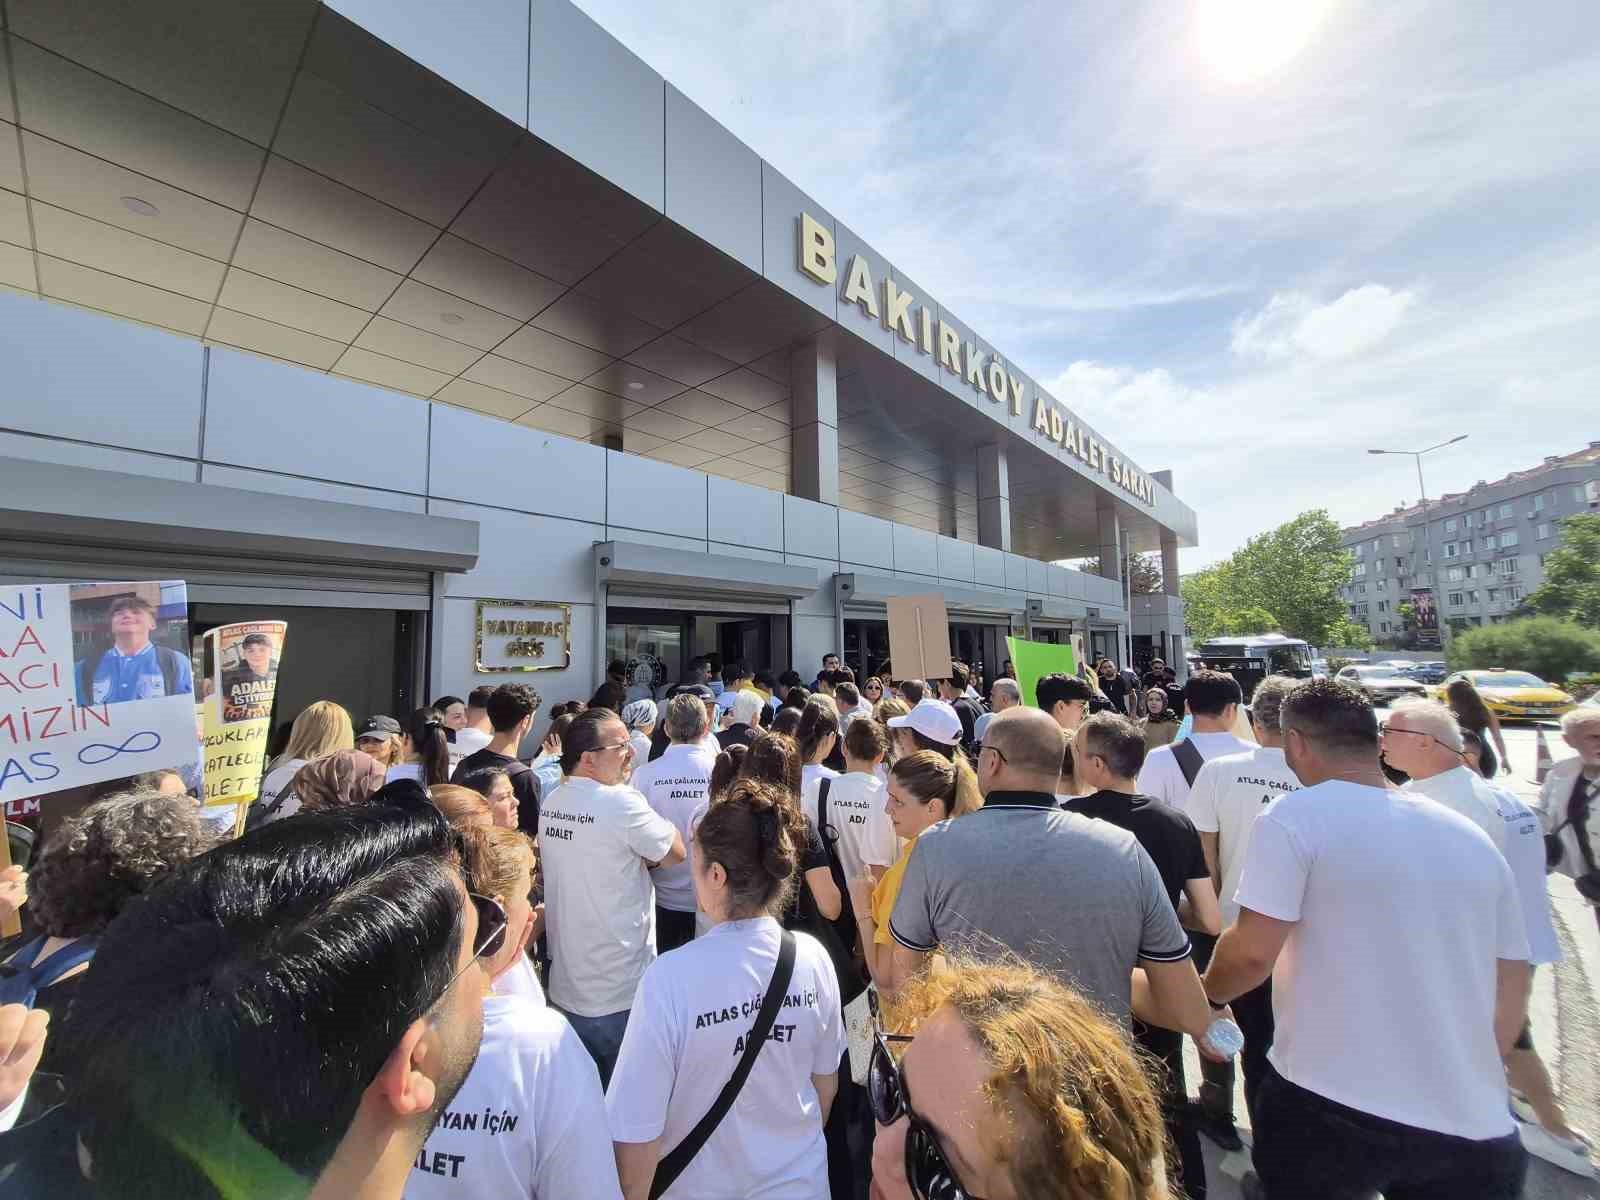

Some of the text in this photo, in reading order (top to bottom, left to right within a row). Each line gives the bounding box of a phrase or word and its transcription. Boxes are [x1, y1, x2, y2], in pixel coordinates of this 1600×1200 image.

[799, 211, 1157, 507] BAKIRKÖY ADALET SARAYI
[1236, 776, 1266, 786] ATLAS
[670, 790, 704, 799] ADALET
[545, 826, 573, 841] ADALET
[695, 1006, 739, 1030] ATLAS
[437, 1107, 519, 1136] YAN İÇİN
